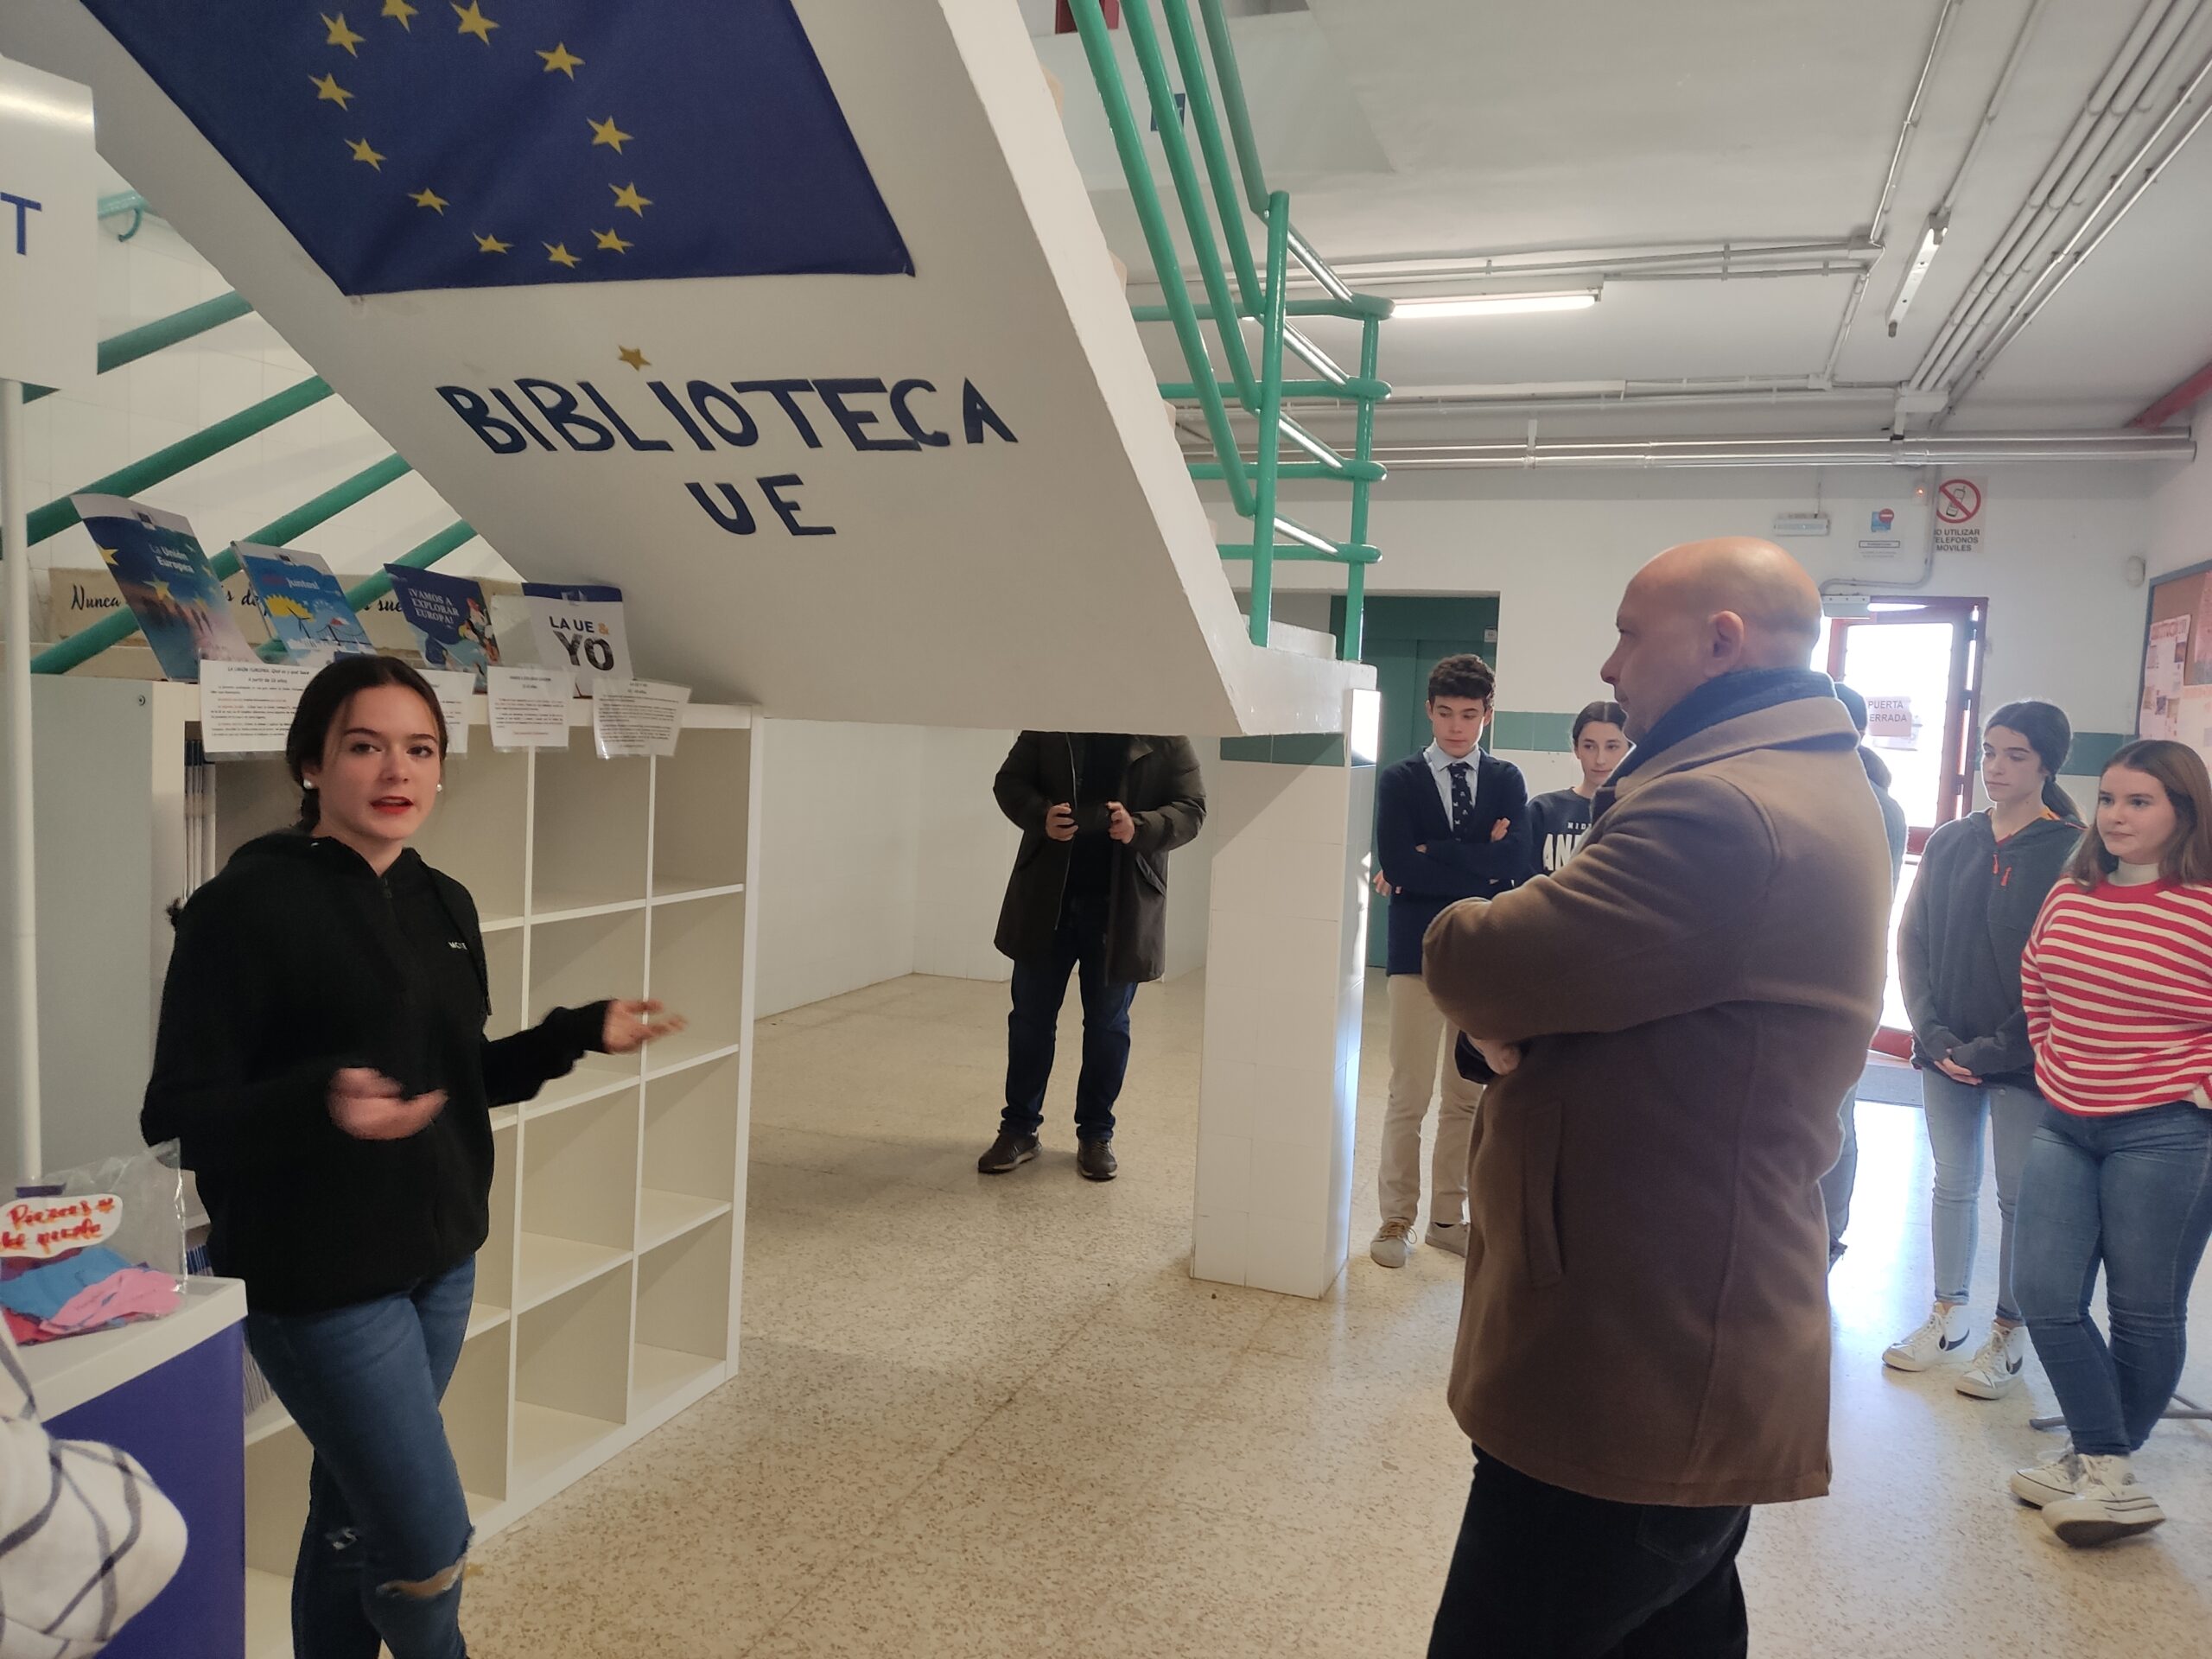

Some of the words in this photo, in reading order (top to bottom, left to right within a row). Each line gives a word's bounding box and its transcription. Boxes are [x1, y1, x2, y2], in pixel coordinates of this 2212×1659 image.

[435, 378, 1019, 454] BIBLIOTECA
[683, 474, 836, 536] UE
[71, 584, 120, 610] Nunca
[378, 600, 403, 612] sue
[411, 597, 460, 616] EXPLORAR
[445, 597, 453, 606] A
[415, 607, 454, 624] EUROPA!
[550, 615, 570, 630] LA
[573, 620, 594, 633] UE
[553, 630, 614, 671] YO
[1867, 700, 1904, 709] PUERTA
[1869, 714, 1907, 722] ERRADA
[1542, 834, 1582, 871] AN
